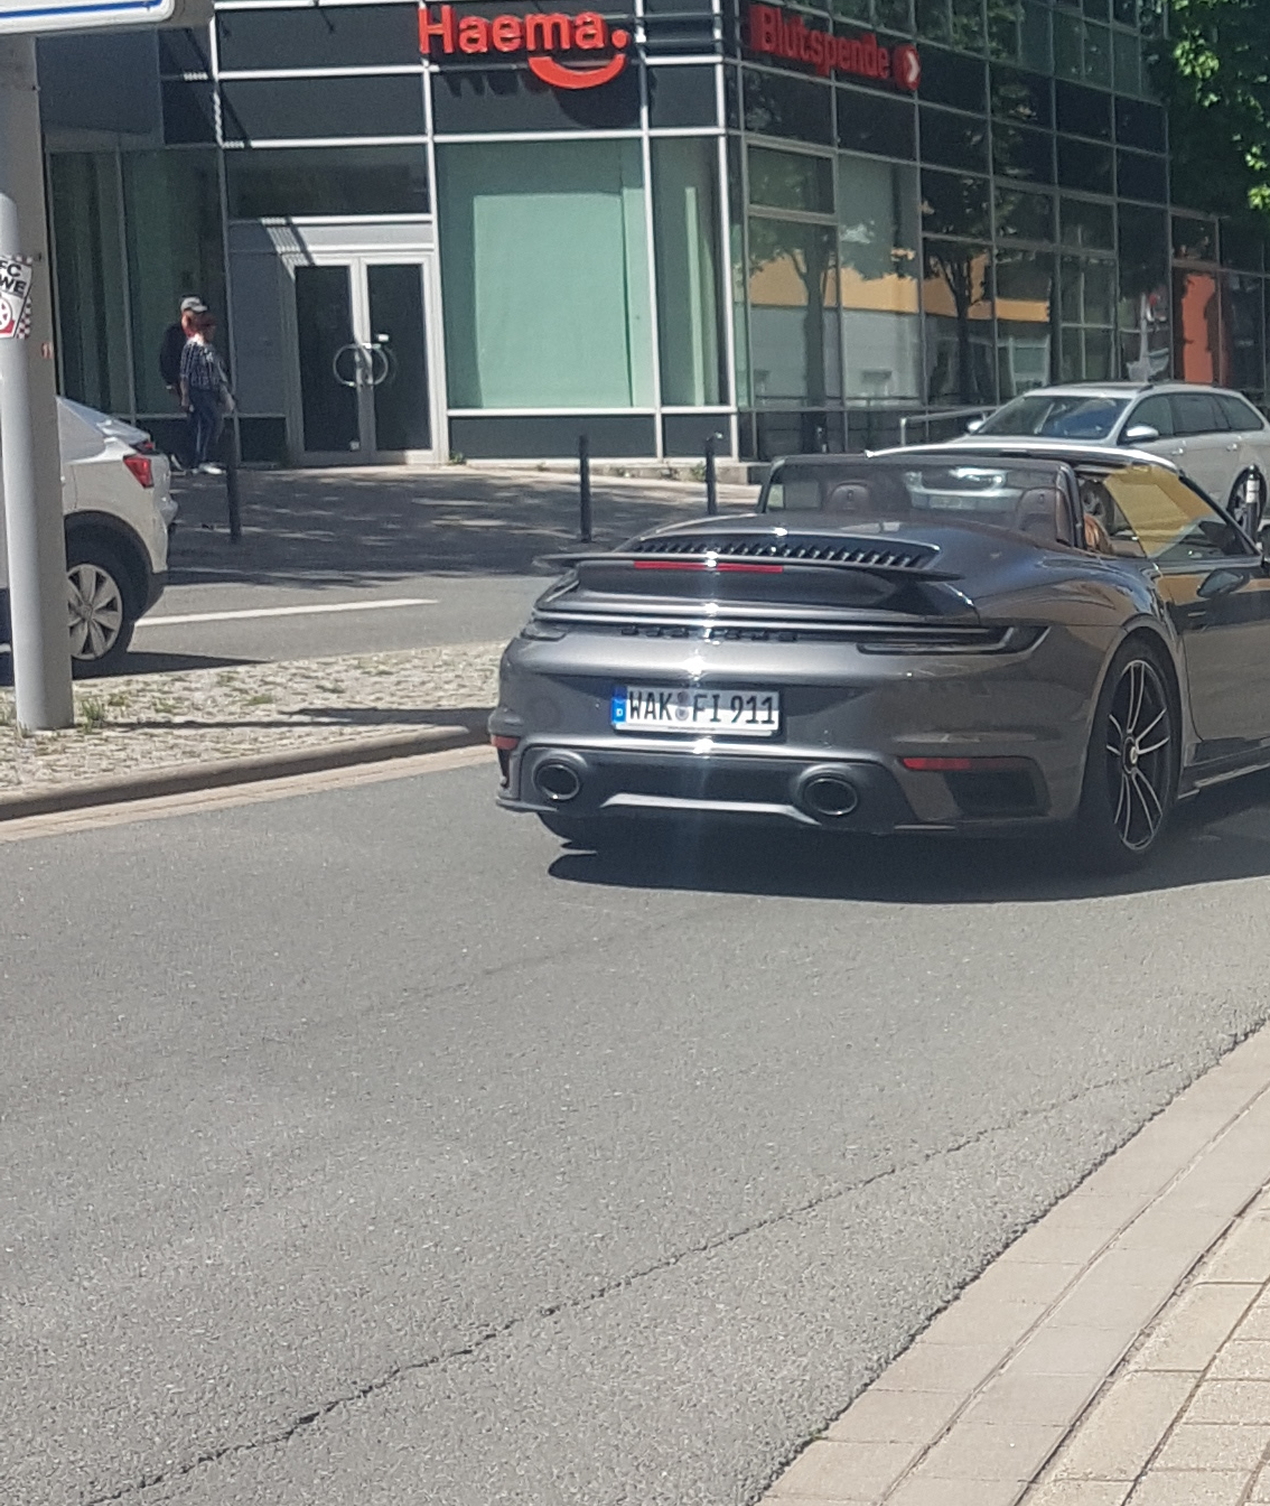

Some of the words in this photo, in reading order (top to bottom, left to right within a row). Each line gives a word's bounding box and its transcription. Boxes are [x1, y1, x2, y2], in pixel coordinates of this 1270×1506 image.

[750, 4, 890, 77] Blutspende
[629, 690, 672, 721] WAK
[692, 694, 721, 722] FI
[730, 695, 775, 725] 911
